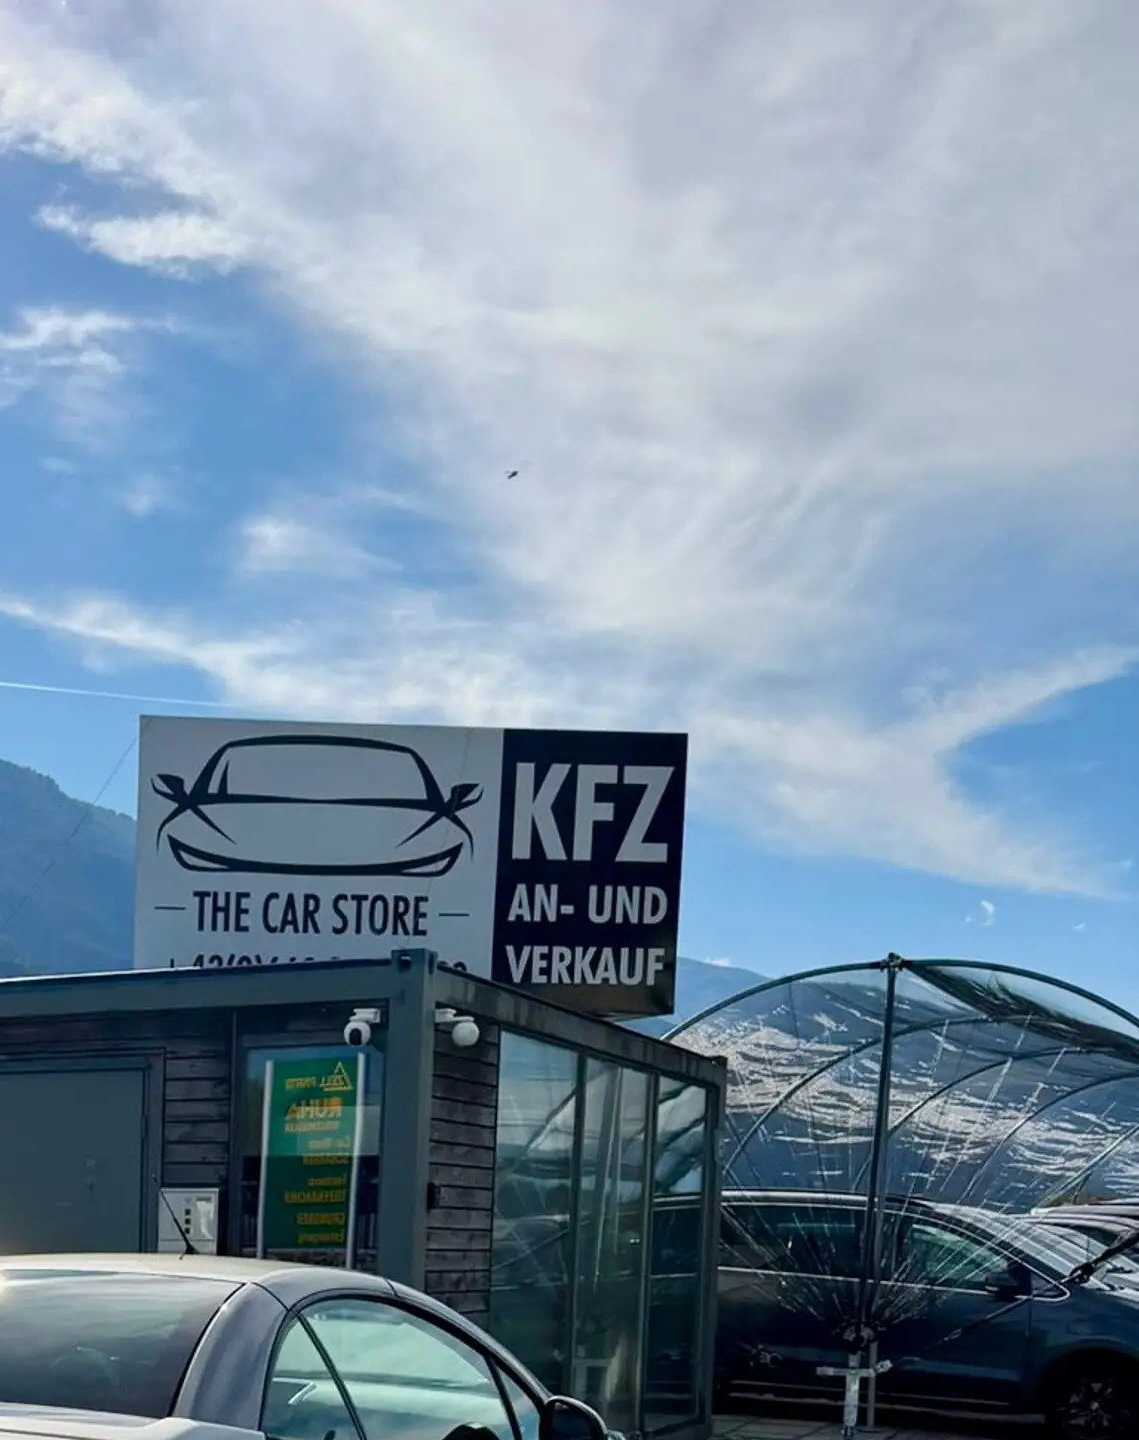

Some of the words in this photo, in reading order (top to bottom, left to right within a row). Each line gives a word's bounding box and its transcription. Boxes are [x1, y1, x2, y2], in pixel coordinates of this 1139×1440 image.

[511, 762, 674, 865] KFZ
[192, 889, 250, 934] THE
[262, 891, 320, 936] CAR
[332, 893, 430, 938] STORE
[508, 883, 574, 924] AN-
[588, 886, 668, 925] UND
[505, 945, 666, 987] VERKAUF
